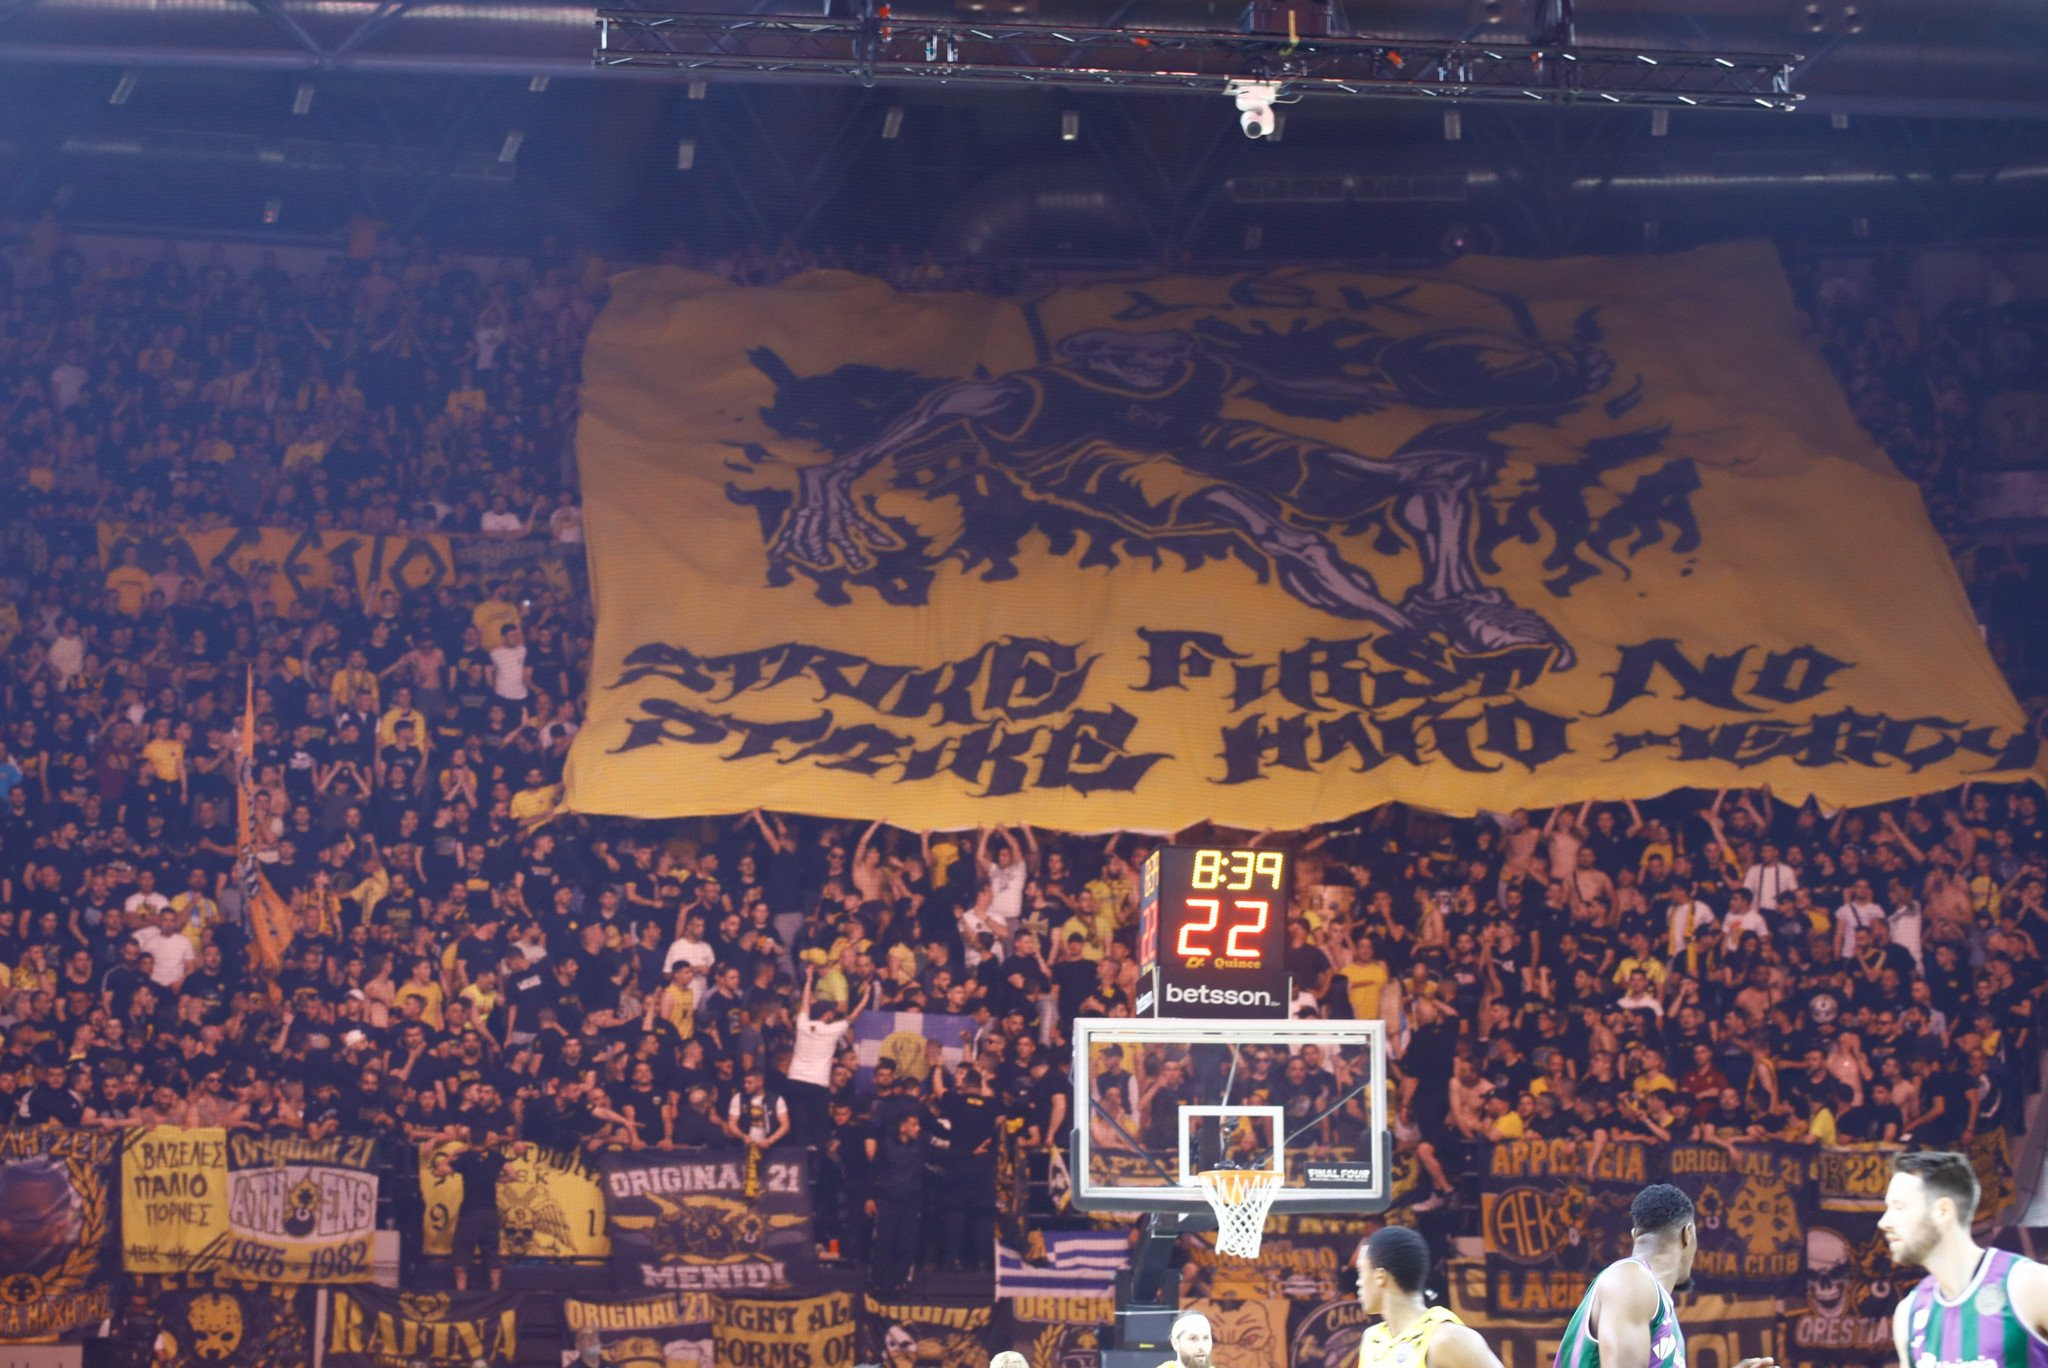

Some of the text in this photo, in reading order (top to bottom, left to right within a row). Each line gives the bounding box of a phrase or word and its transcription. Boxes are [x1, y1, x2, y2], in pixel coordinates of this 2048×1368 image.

[1584, 637, 1855, 717] NO
[1207, 700, 1578, 785] HARD
[1191, 849, 1283, 891] 8:39
[1176, 898, 1269, 958] 22
[1166, 983, 1271, 1006] betsson
[134, 1172, 208, 1199] ΠΑΛΙΟ
[610, 1163, 745, 1198] ORIGINA
[768, 1164, 800, 1193] 21
[1307, 1168, 1371, 1180] FINAL FOUR
[1779, 1157, 1803, 1187] 21
[229, 1170, 373, 1236] ATHENS
[1496, 1189, 1558, 1257] AEK
[308, 1240, 369, 1281] 1982
[327, 1291, 518, 1364] RAFINA
[568, 1292, 711, 1331] ORIGINAL 21
[1014, 1297, 1116, 1326] ORIGIN
[1796, 1316, 1894, 1347] ORESTIA
